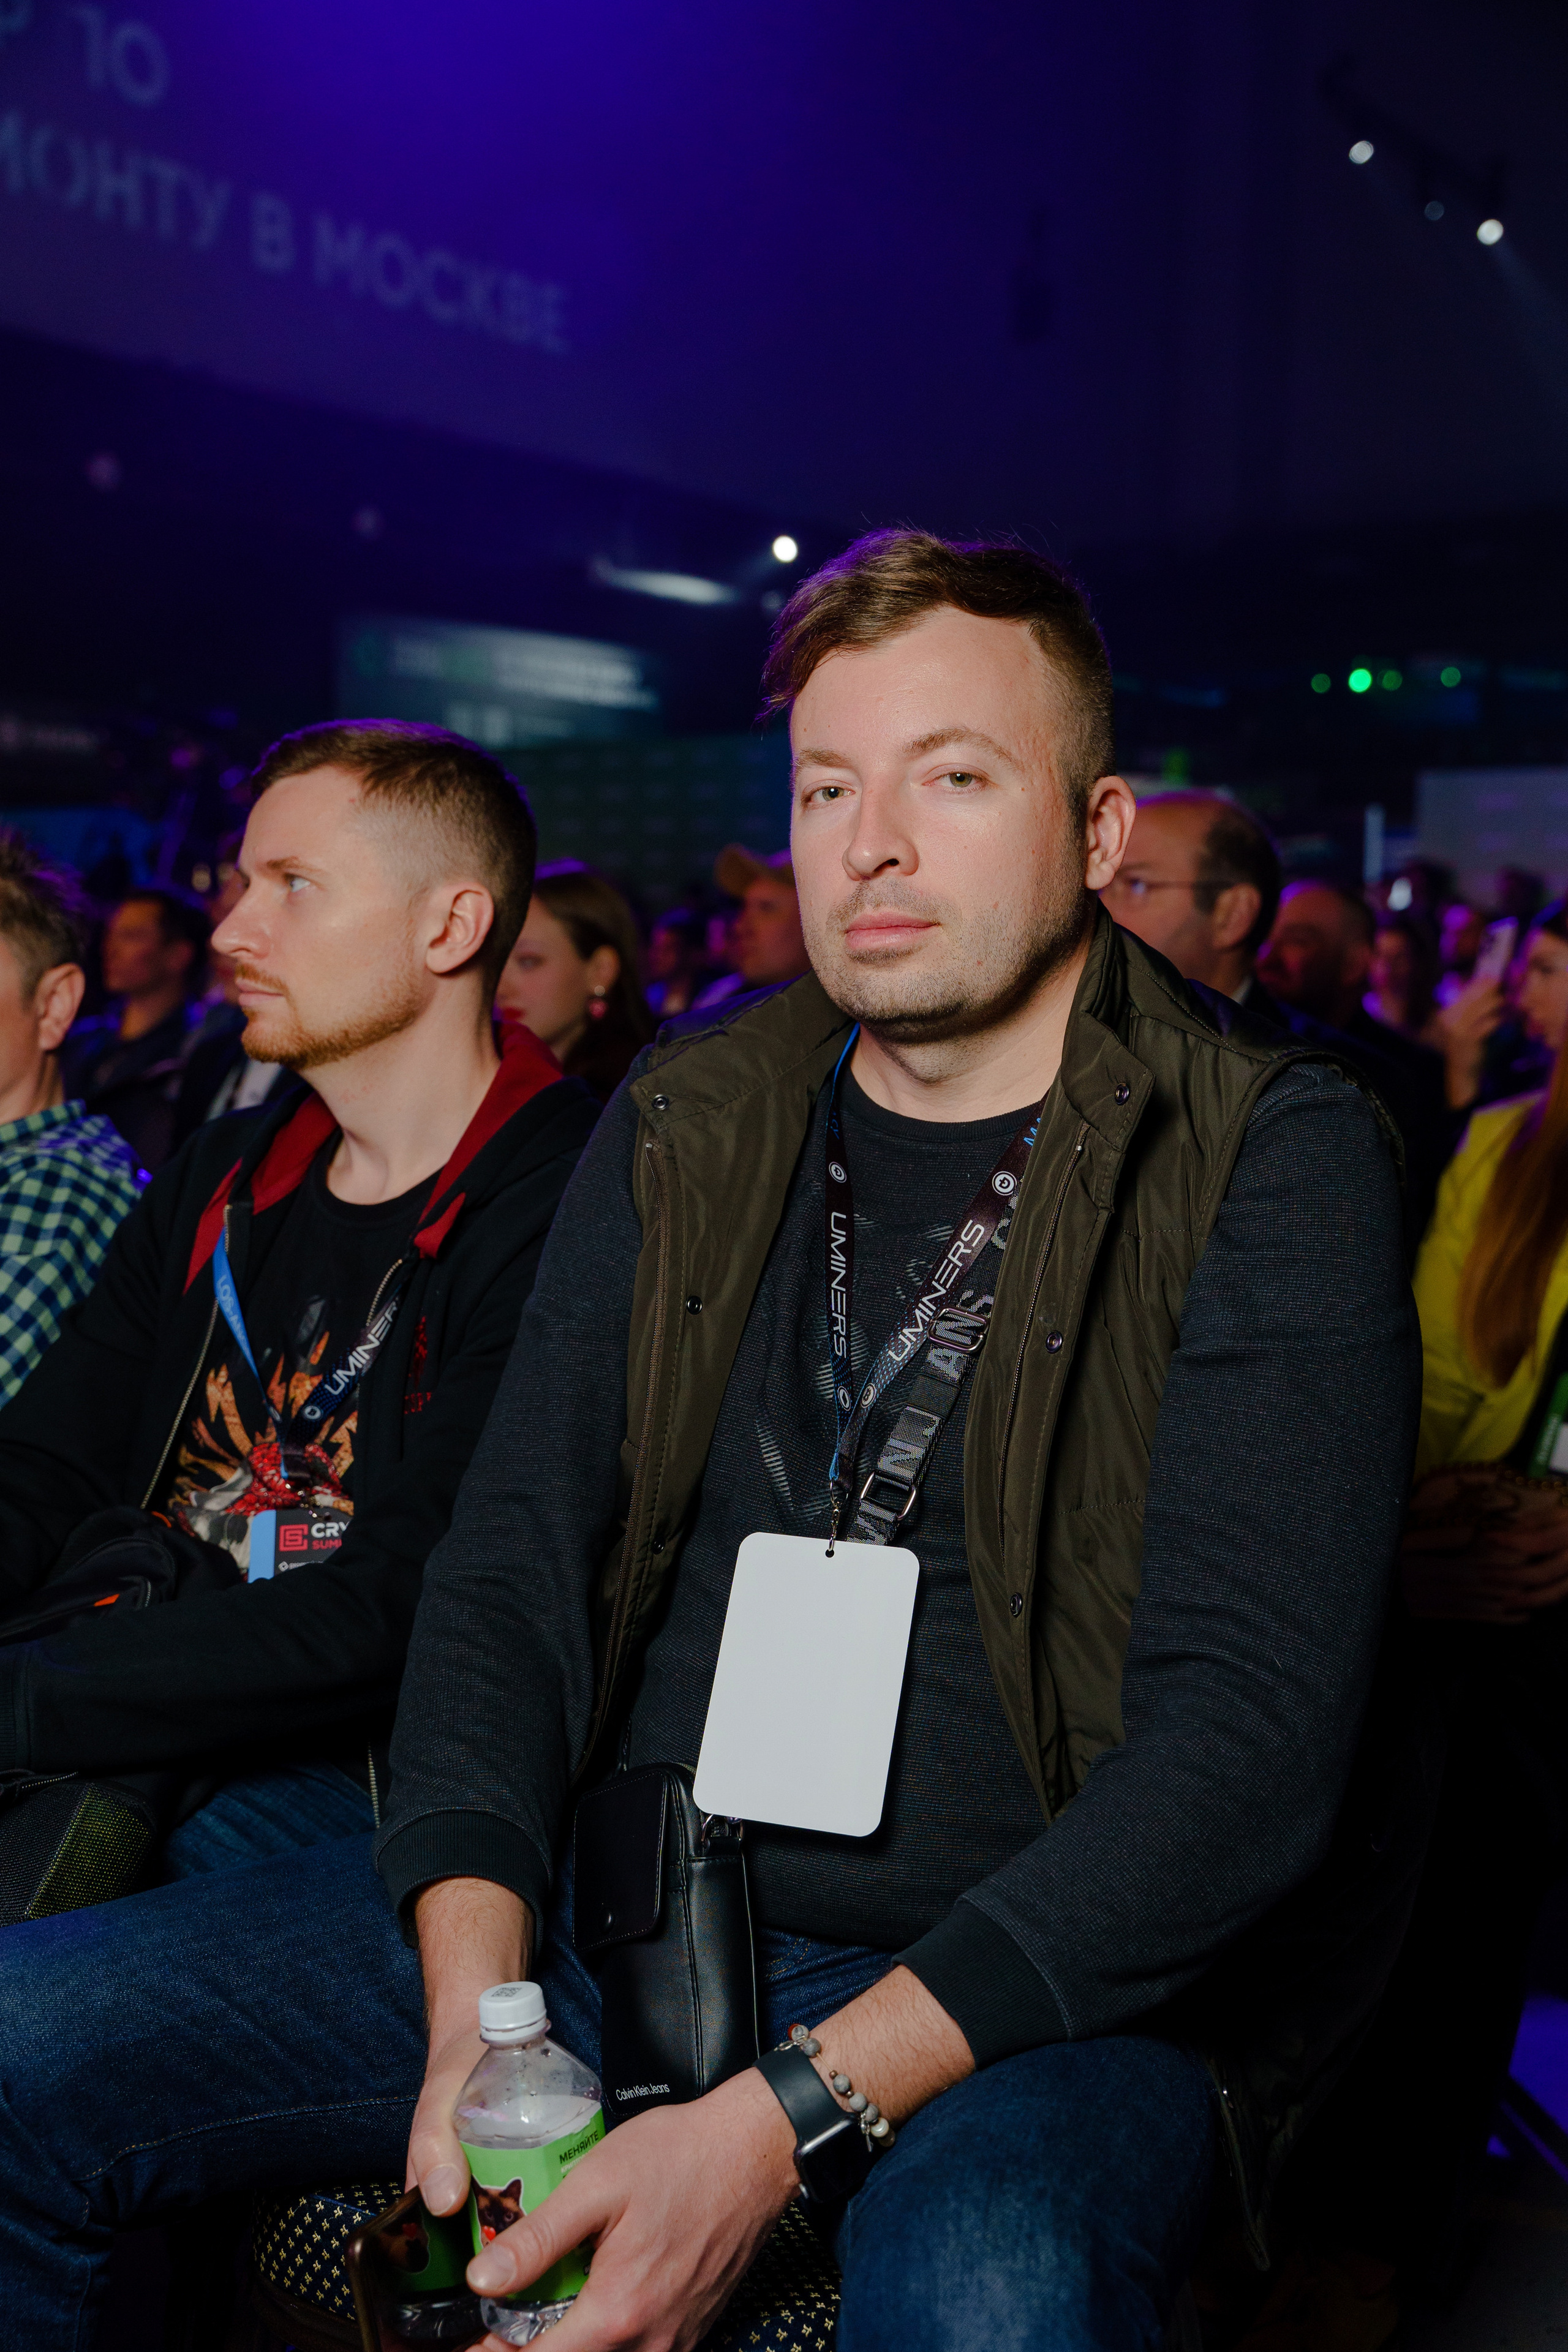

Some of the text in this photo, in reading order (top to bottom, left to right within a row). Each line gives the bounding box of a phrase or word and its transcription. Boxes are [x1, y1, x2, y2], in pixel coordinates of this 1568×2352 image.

[831, 1212, 846, 1359] UMINERS
[888, 1219, 985, 1361] UMINERS
[616, 2082, 670, 2101] Calvin Klein Jeans
[559, 2130, 599, 2164] МЕНЯЙТЕ
